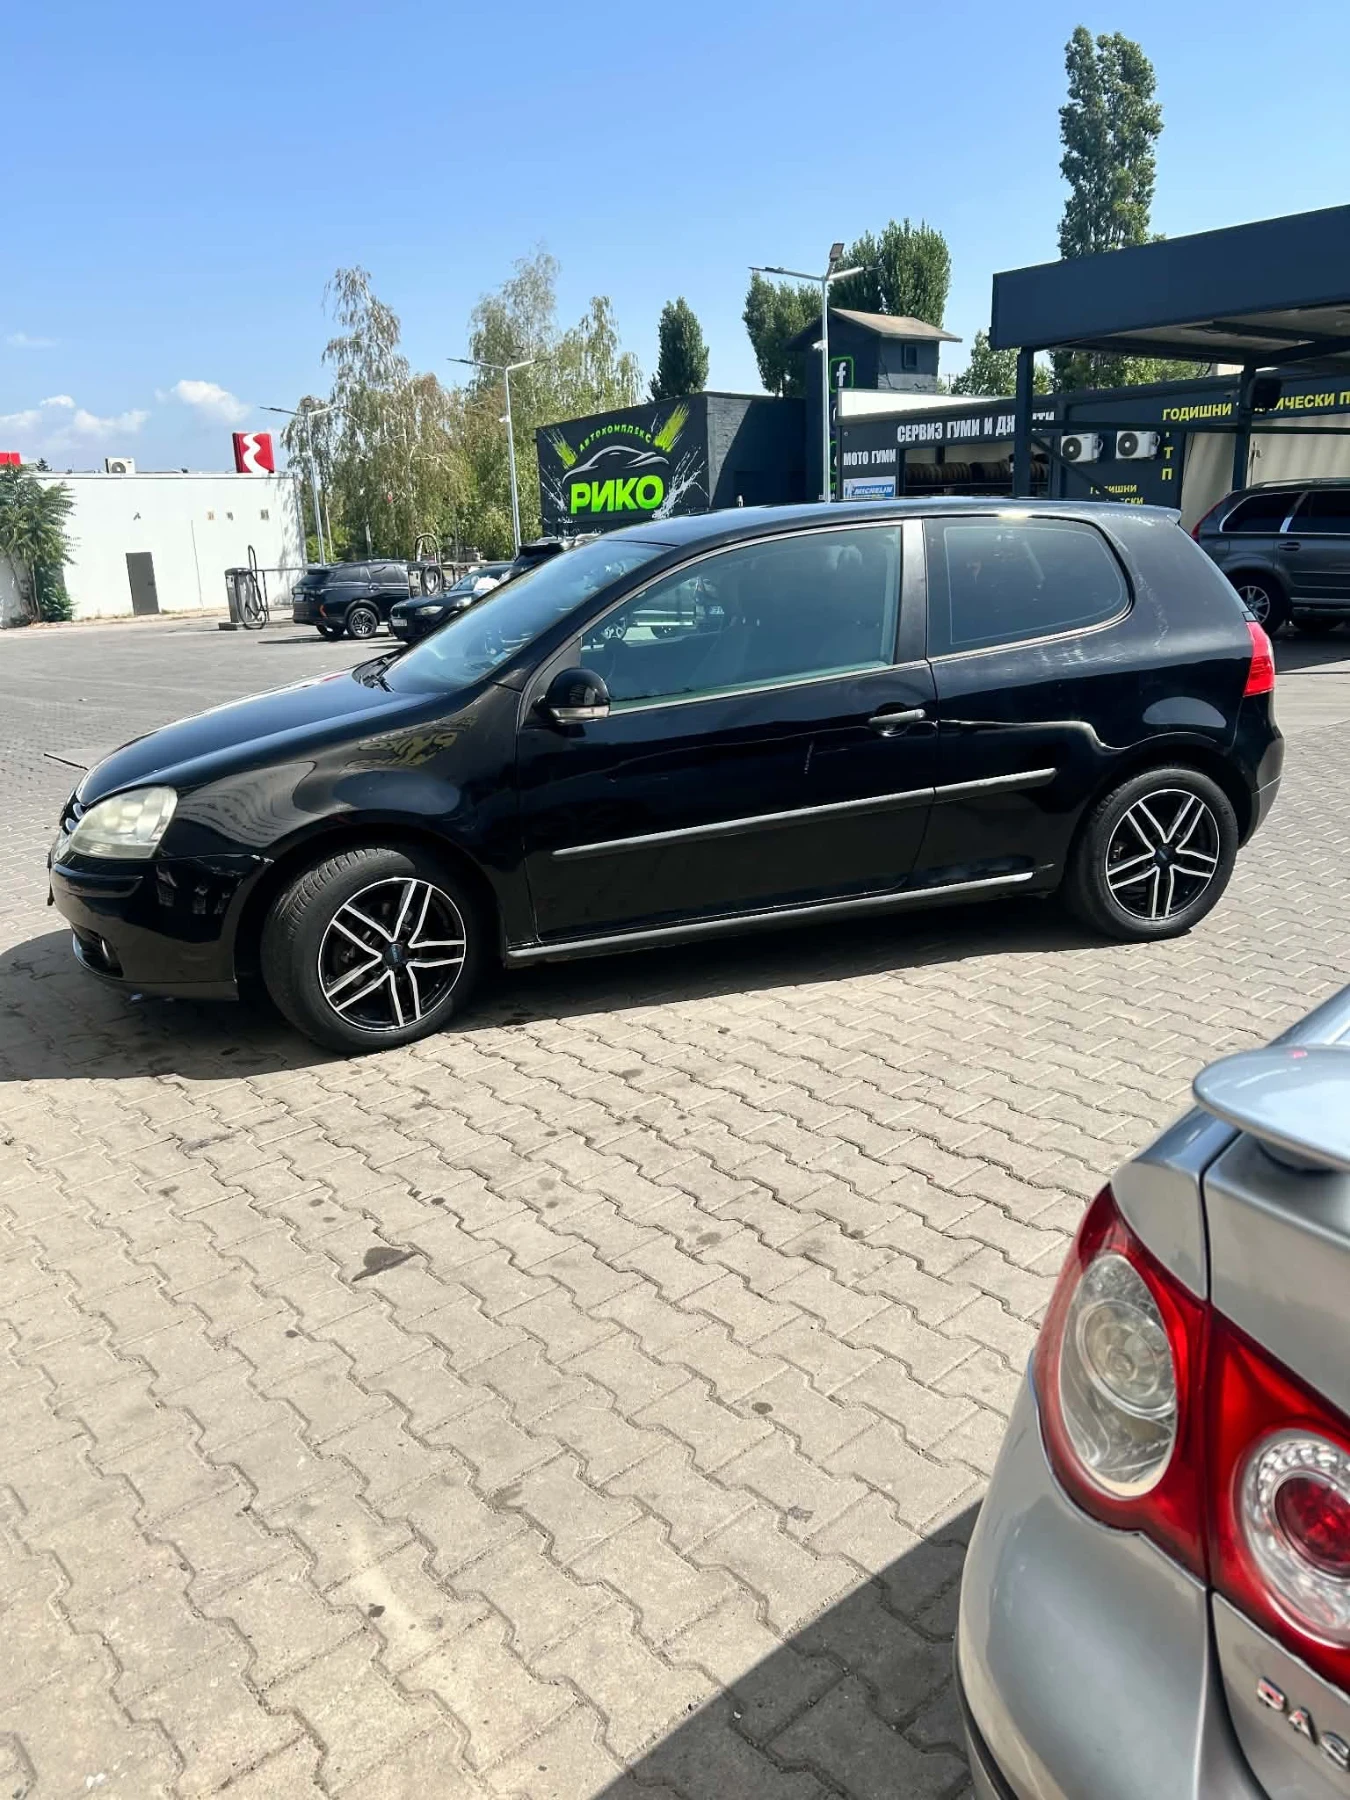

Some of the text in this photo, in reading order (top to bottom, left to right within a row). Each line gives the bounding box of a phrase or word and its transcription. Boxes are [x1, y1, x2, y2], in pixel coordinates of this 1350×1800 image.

[1163, 402, 1232, 421] ГОДИШНИ
[580, 423, 652, 452] АВТОКОМПЛЕКС
[897, 422, 942, 443] СЕРВИЗ
[947, 418, 980, 439] ГУМИ
[984, 416, 993, 435] И
[843, 448, 896, 466] МОТО ГУМИ
[570, 474, 664, 515] РИКО
